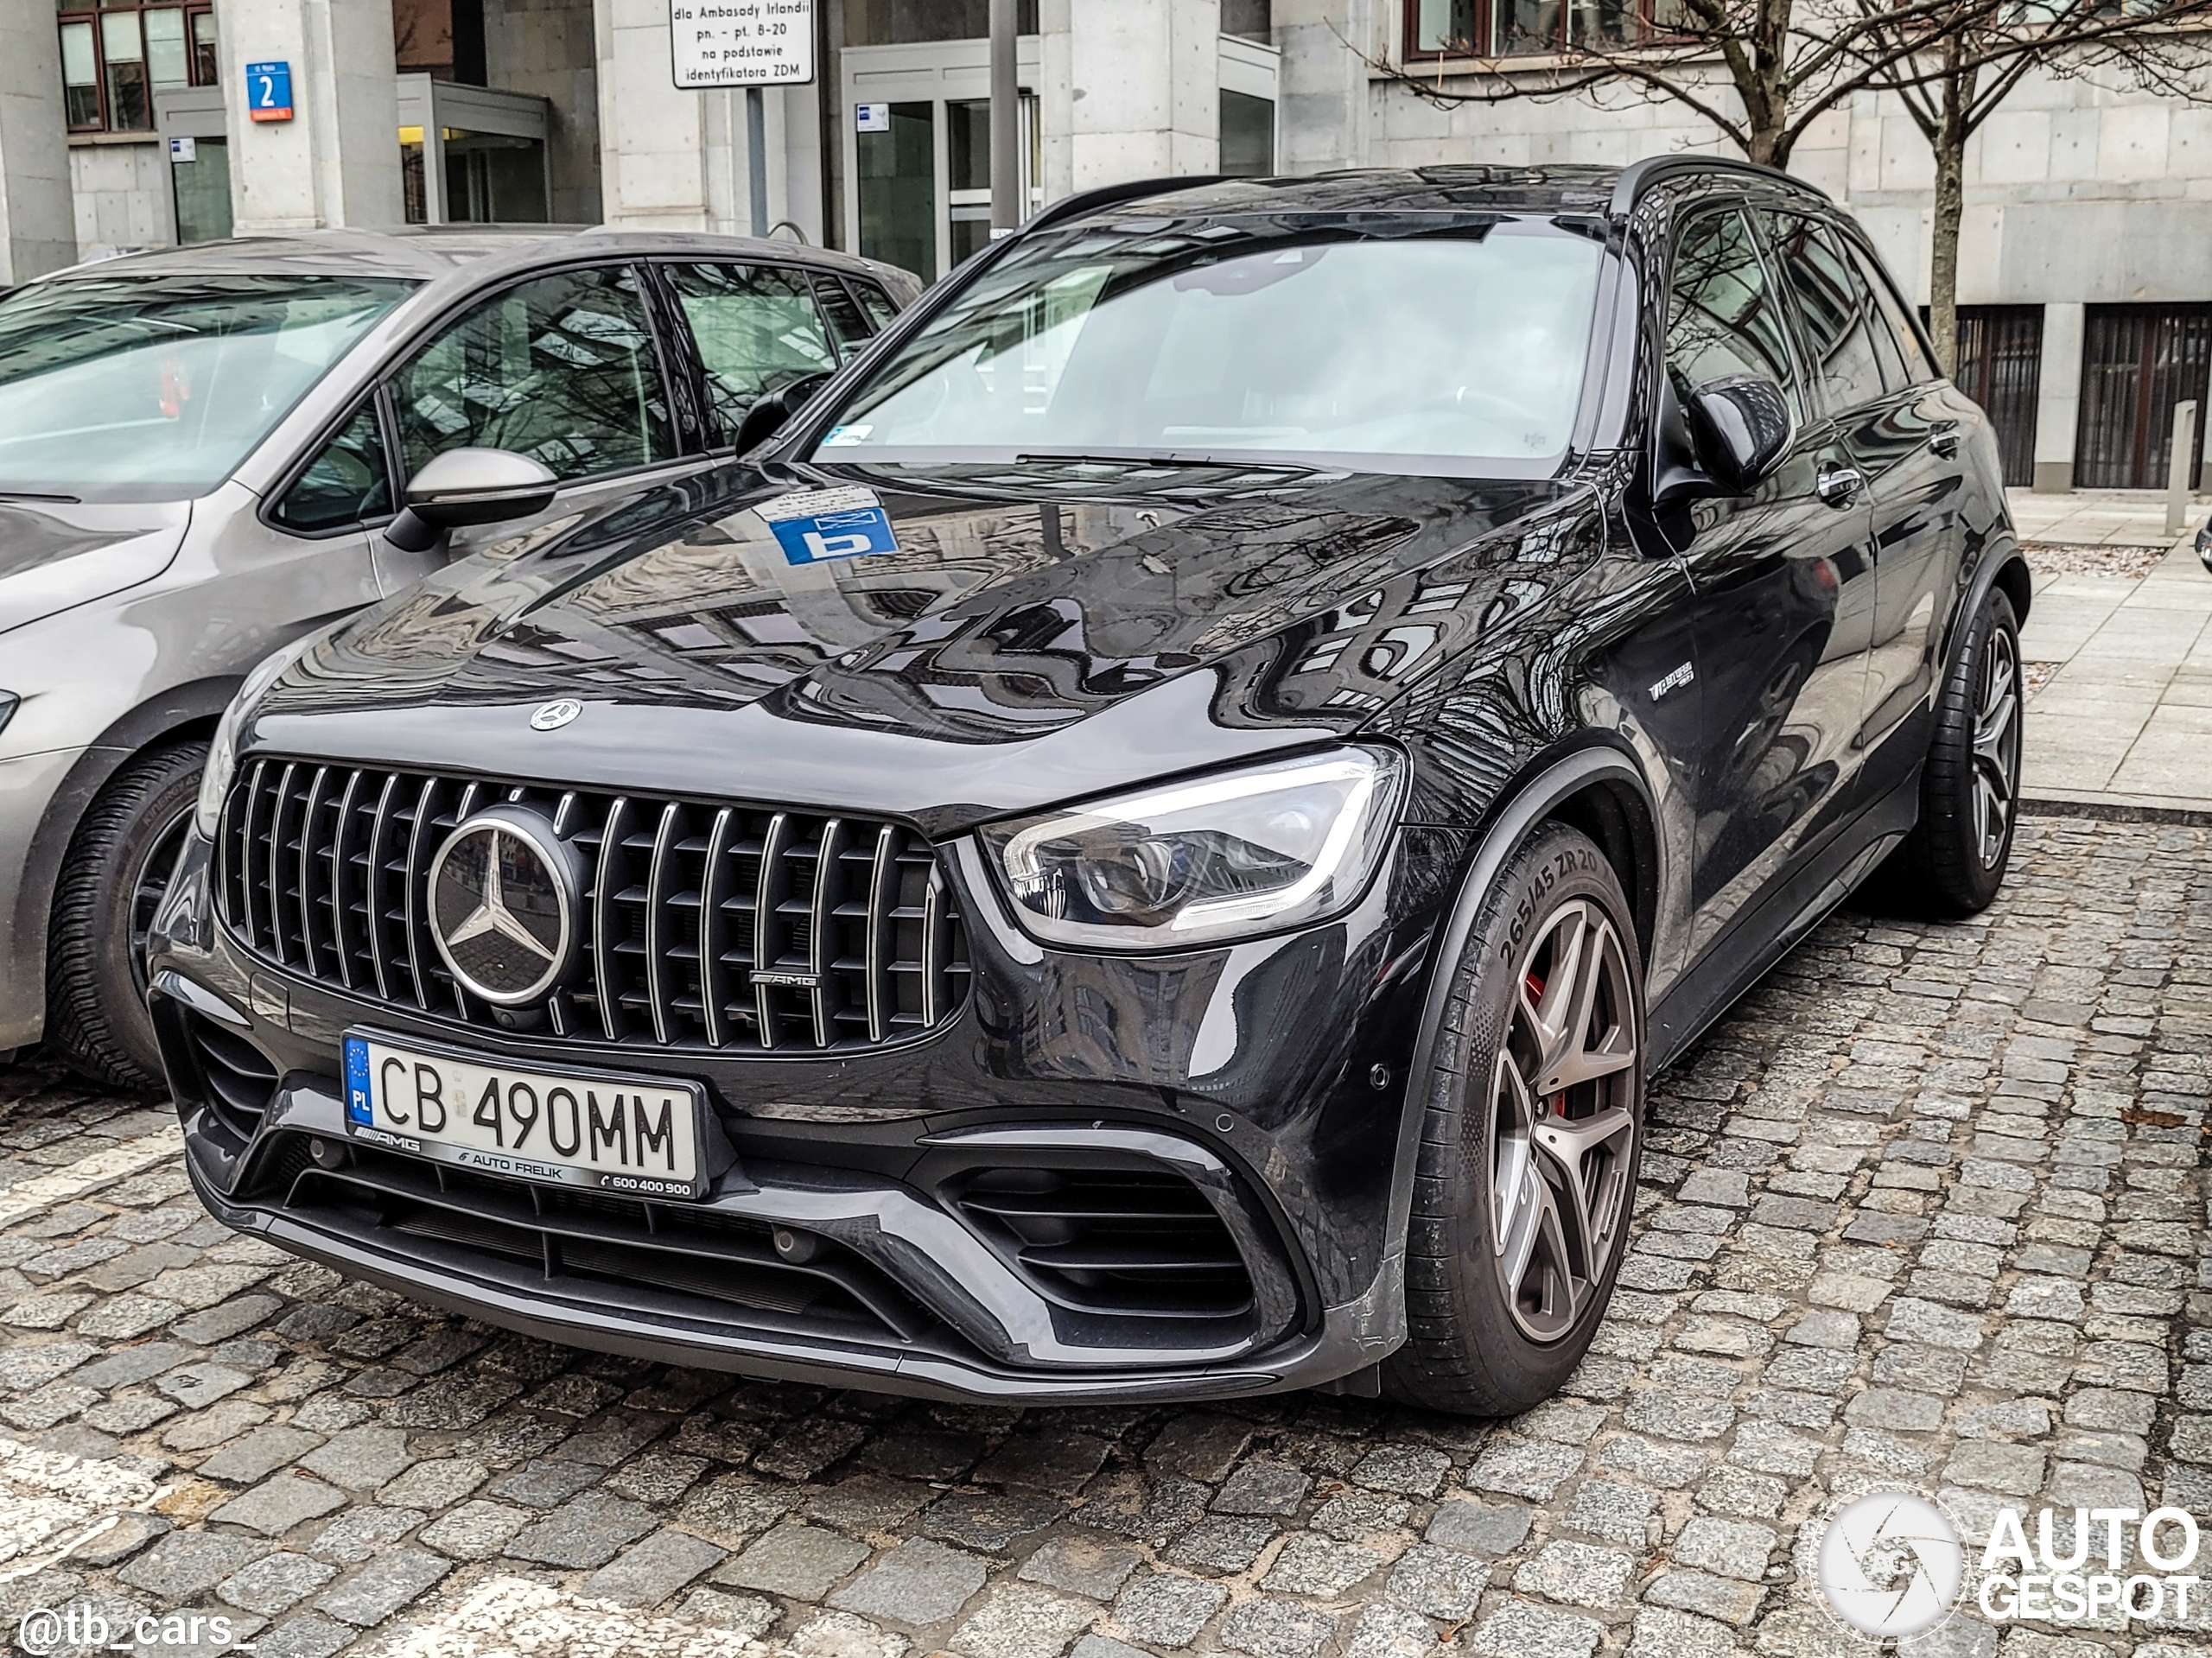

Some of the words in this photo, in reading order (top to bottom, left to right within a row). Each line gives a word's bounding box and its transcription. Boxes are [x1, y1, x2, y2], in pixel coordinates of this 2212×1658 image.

[675, 8, 692, 20] dla
[700, 4, 760, 19] Ambasady
[767, 1, 810, 15] Irlandii
[697, 30, 715, 42] pn.
[735, 26, 750, 41] pt.
[702, 50, 716, 60] na
[724, 44, 783, 61] podstawie
[686, 67, 766, 82] identyfikatora
[773, 63, 800, 77] ZDM
[259, 75, 275, 107] 2
[1499, 865, 1554, 969] 265/45
[771, 975, 817, 986] AMG
[352, 1089, 370, 1111] PL
[381, 1057, 447, 1134] CB
[473, 1077, 675, 1171] 490MM
[375, 1132, 421, 1153] AMG
[473, 1154, 511, 1169] AUTO
[515, 1162, 563, 1178] FRELIK
[613, 1177, 638, 1189] 600
[639, 1178, 664, 1192] 400
[664, 1182, 690, 1195] 900
